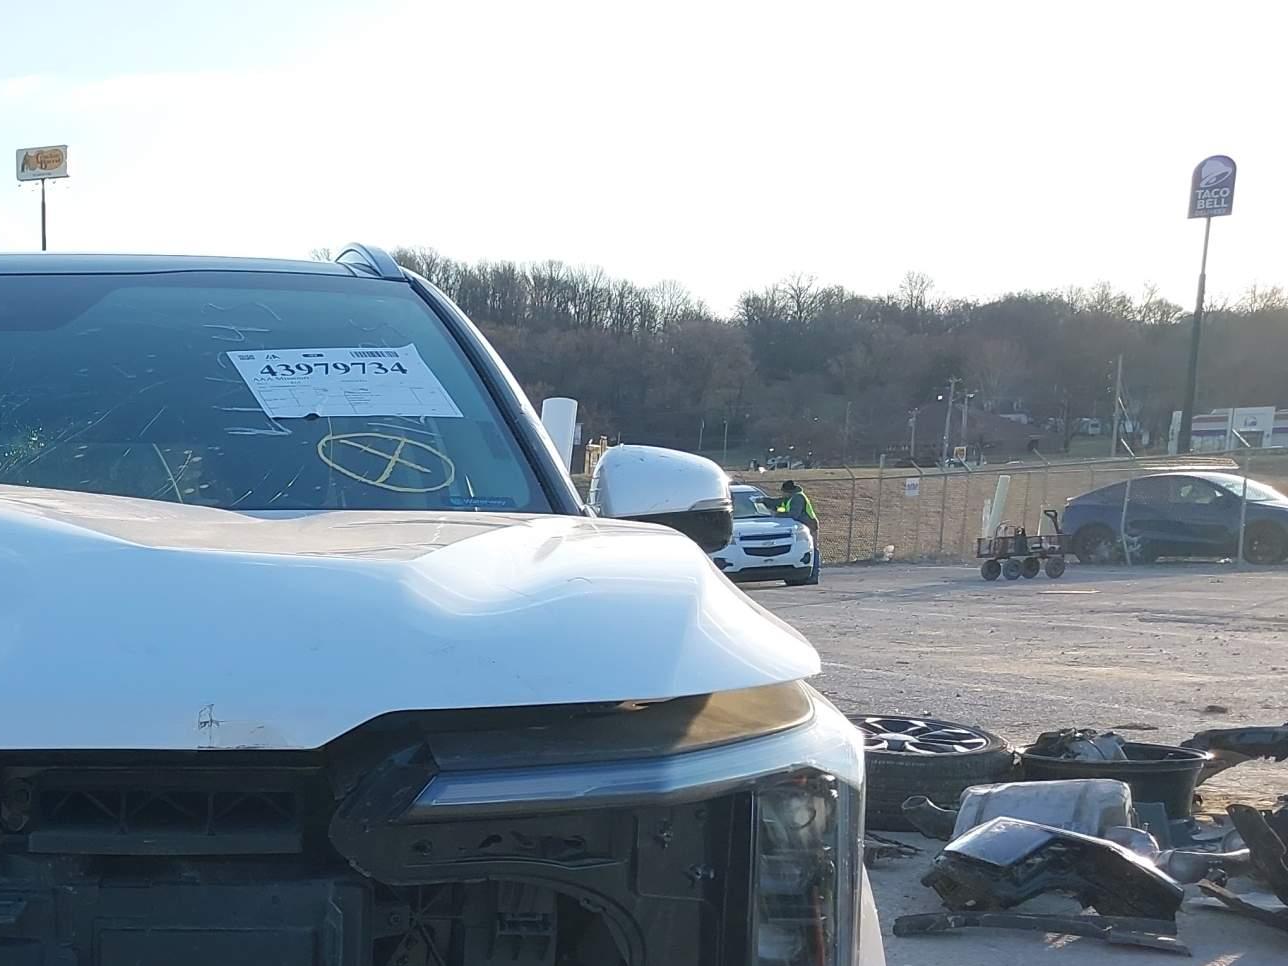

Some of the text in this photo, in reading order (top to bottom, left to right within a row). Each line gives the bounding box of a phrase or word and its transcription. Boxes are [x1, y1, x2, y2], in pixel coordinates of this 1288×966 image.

[1196, 187, 1231, 199] TACO
[1197, 198, 1228, 209] BELL
[260, 360, 409, 378] 43979734
